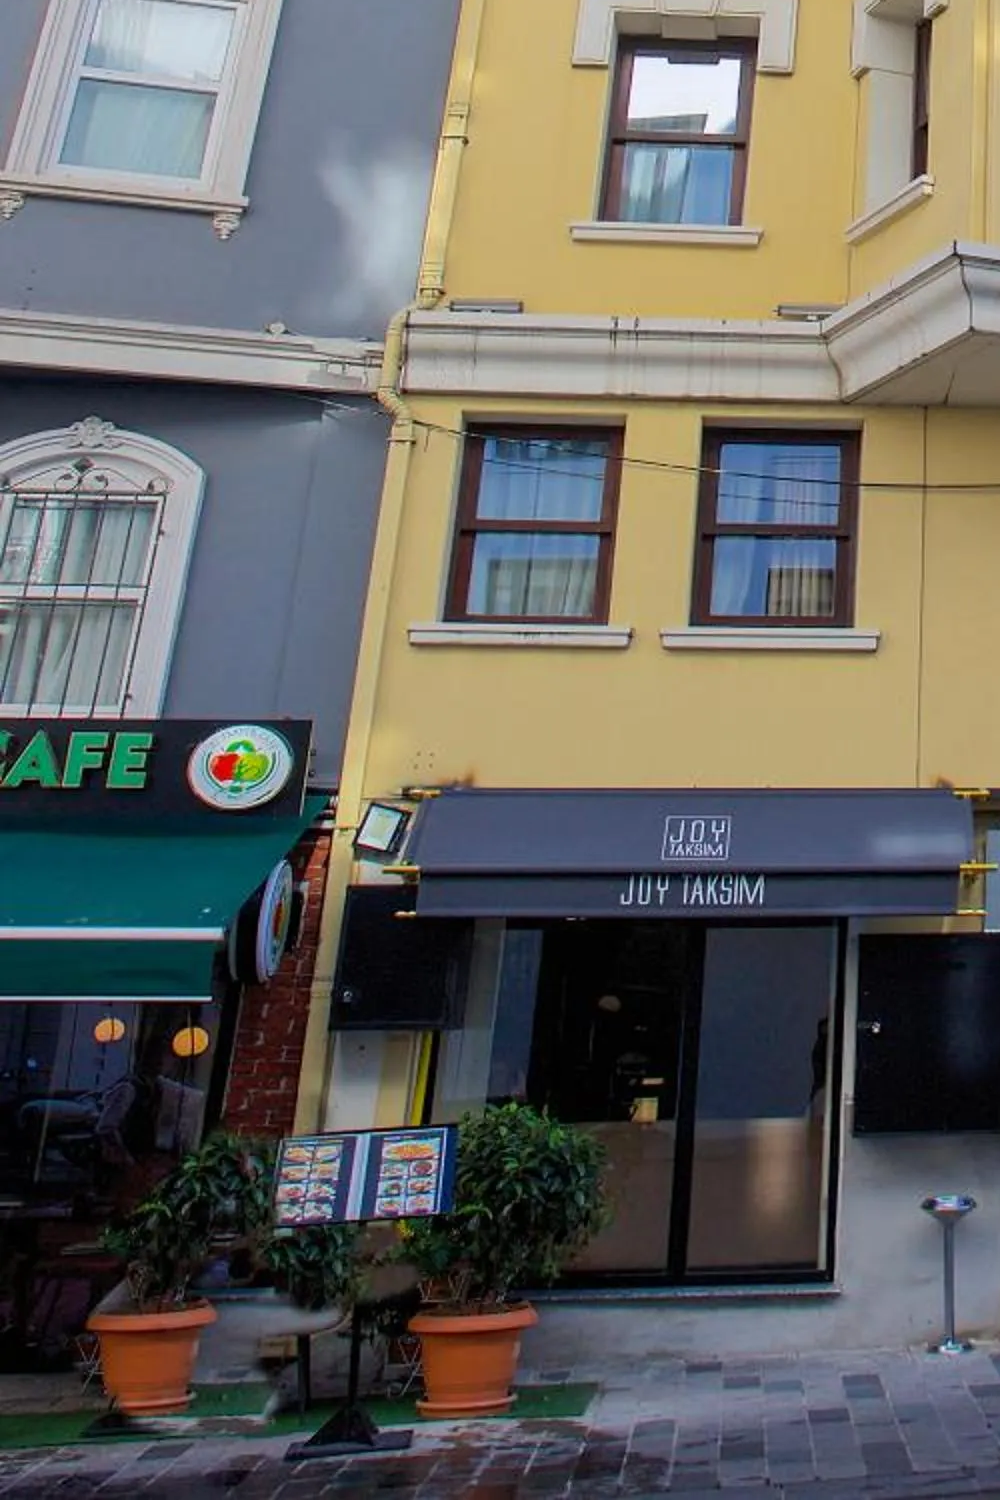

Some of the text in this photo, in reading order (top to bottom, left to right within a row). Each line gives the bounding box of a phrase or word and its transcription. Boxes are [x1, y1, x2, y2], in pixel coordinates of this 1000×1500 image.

[0, 729, 153, 788] AFE
[669, 819, 725, 843] JOY
[620, 873, 765, 906] JOY TAKSIM
